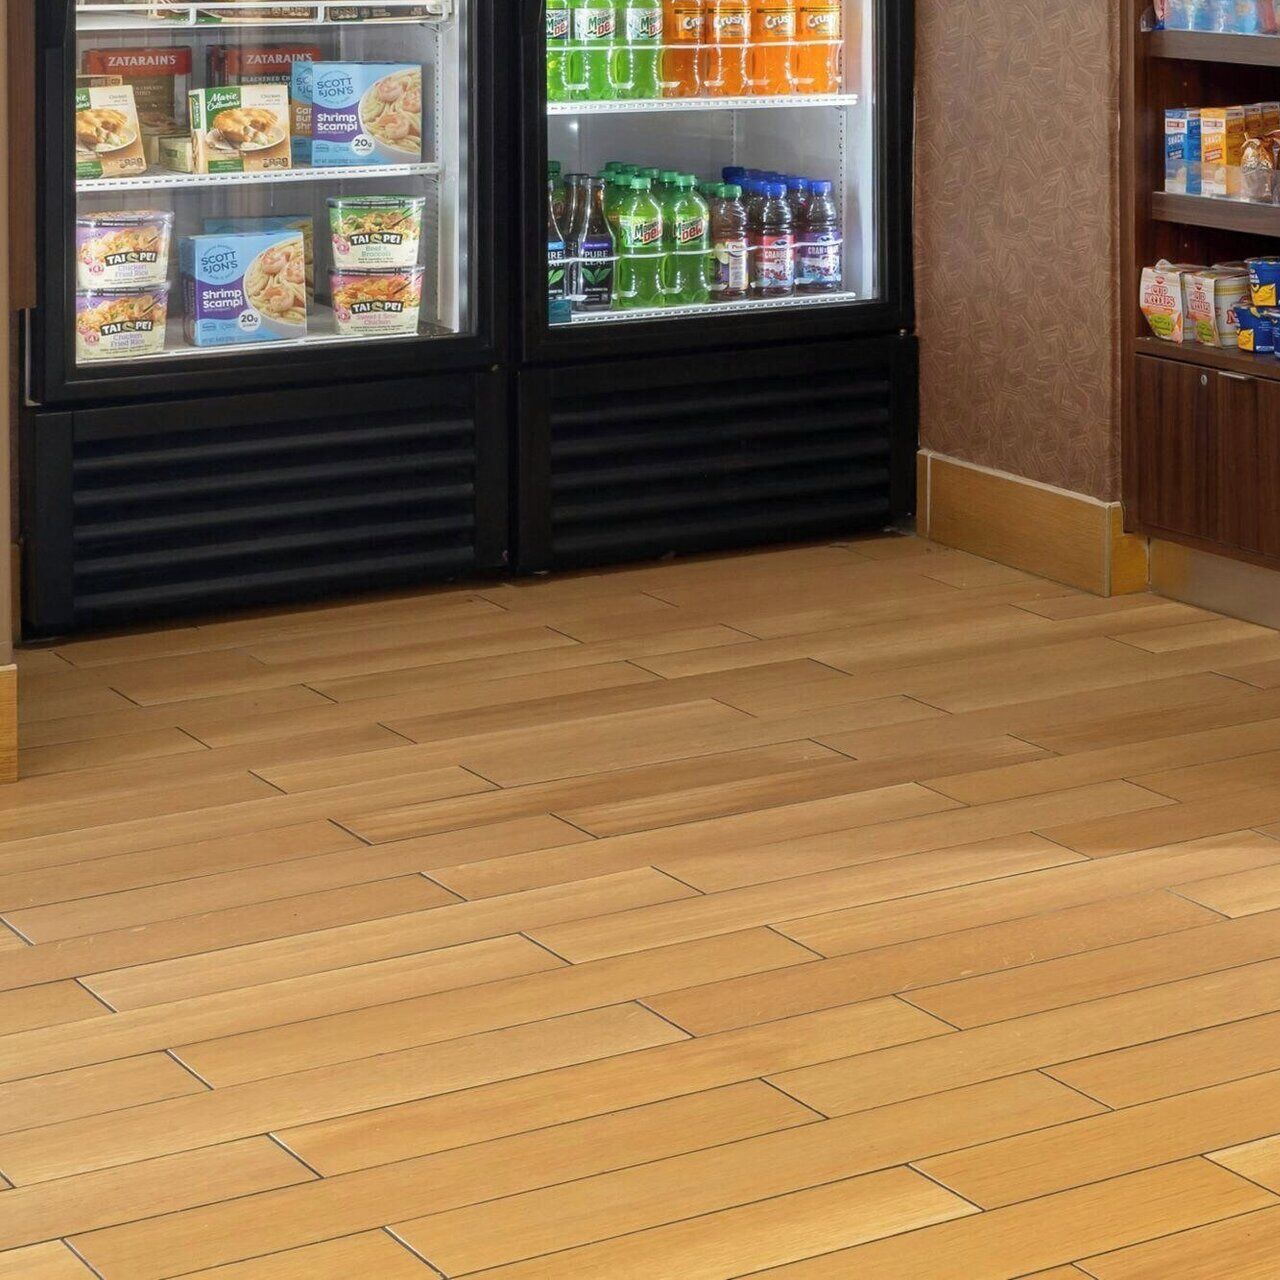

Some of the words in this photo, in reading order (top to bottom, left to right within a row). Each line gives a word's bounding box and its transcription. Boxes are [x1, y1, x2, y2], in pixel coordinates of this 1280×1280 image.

[108, 55, 178, 67] ZATARAIN'S
[246, 53, 313, 65] ZATARAIN'S
[316, 77, 353, 90] SCOTT
[209, 92, 239, 104] Marie
[316, 112, 357, 123] Shrimp
[317, 121, 358, 132] Scampi
[351, 234, 369, 245] TAI
[382, 234, 402, 244] PEI
[107, 253, 126, 265] TAI
[139, 252, 156, 262] PEI
[201, 250, 237, 266] SCOTT
[584, 250, 608, 258] PURE
[202, 288, 243, 300] Shrimp
[202, 297, 244, 309] Scampi
[352, 303, 371, 313] TAI
[384, 302, 402, 311] PEI
[101, 323, 121, 334] TAI
[135, 321, 152, 330] PEI
